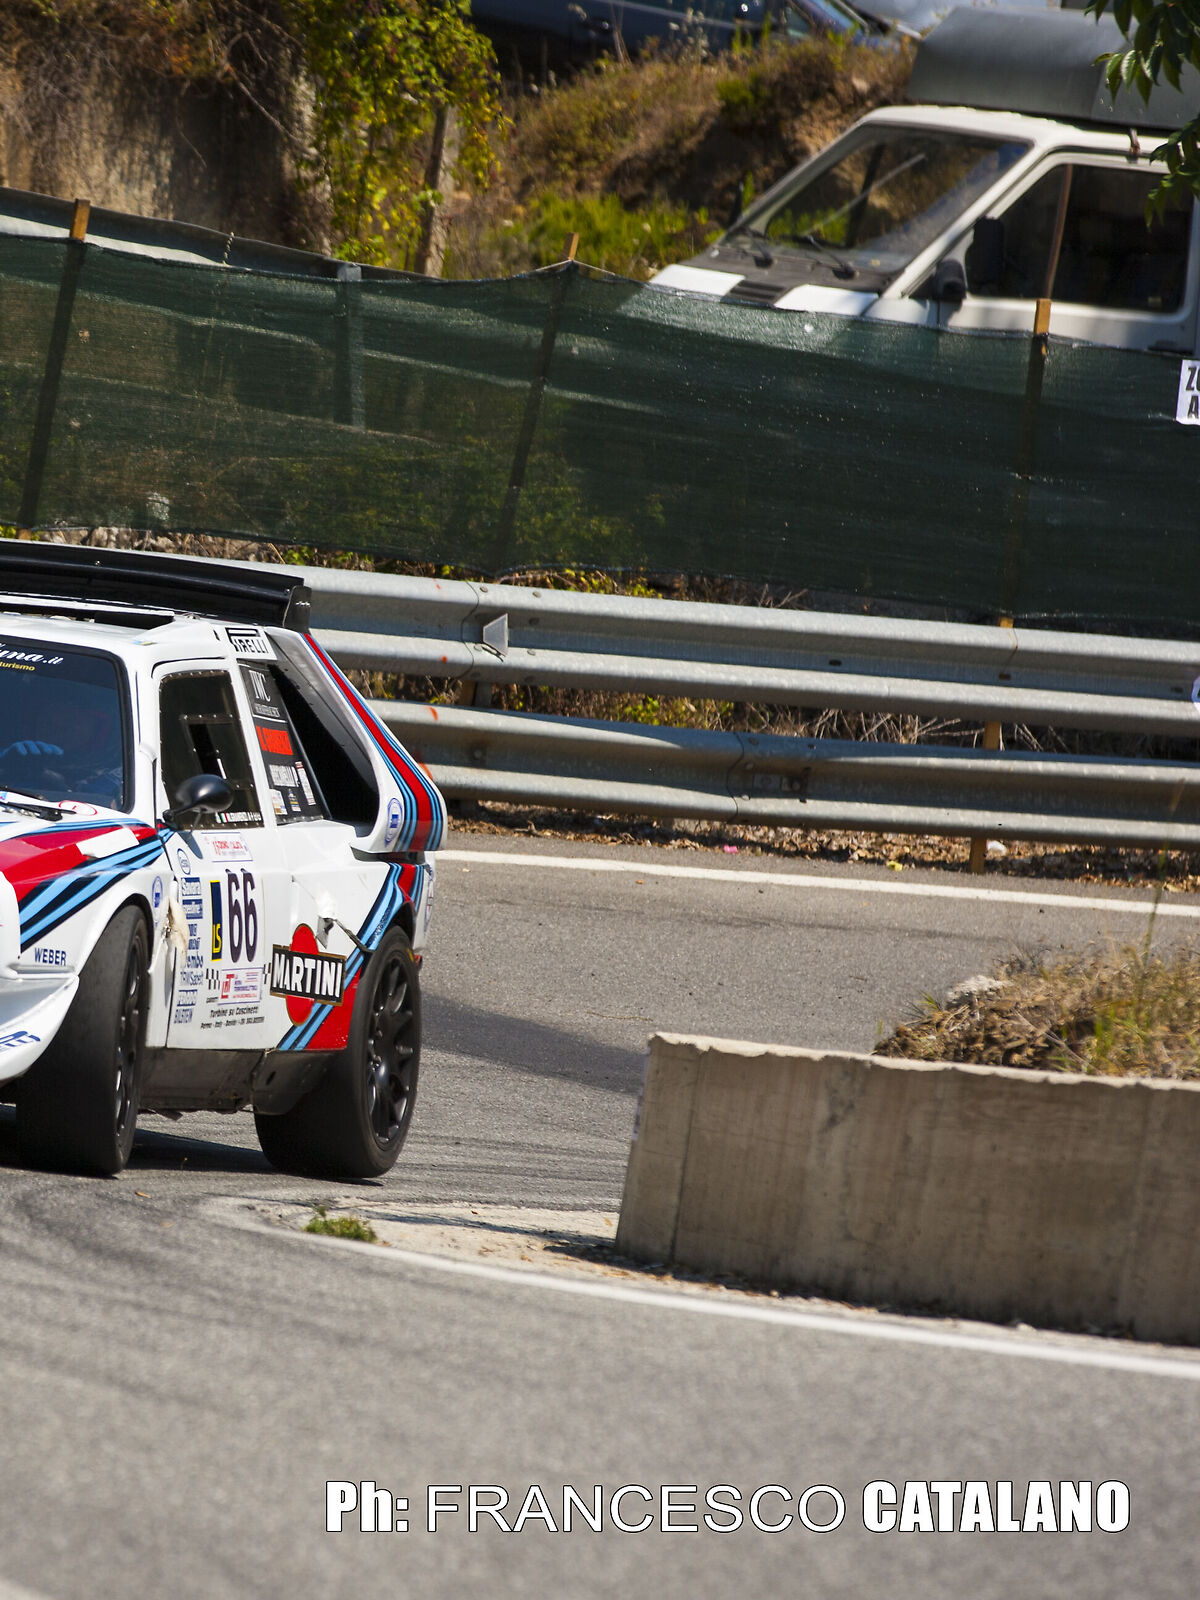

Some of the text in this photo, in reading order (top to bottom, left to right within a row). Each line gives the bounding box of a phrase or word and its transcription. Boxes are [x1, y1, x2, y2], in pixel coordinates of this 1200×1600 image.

[225, 627, 269, 653] PIRELLI
[225, 868, 258, 963] 66
[34, 948, 67, 966] WEBER
[273, 952, 343, 998] MARTINI
